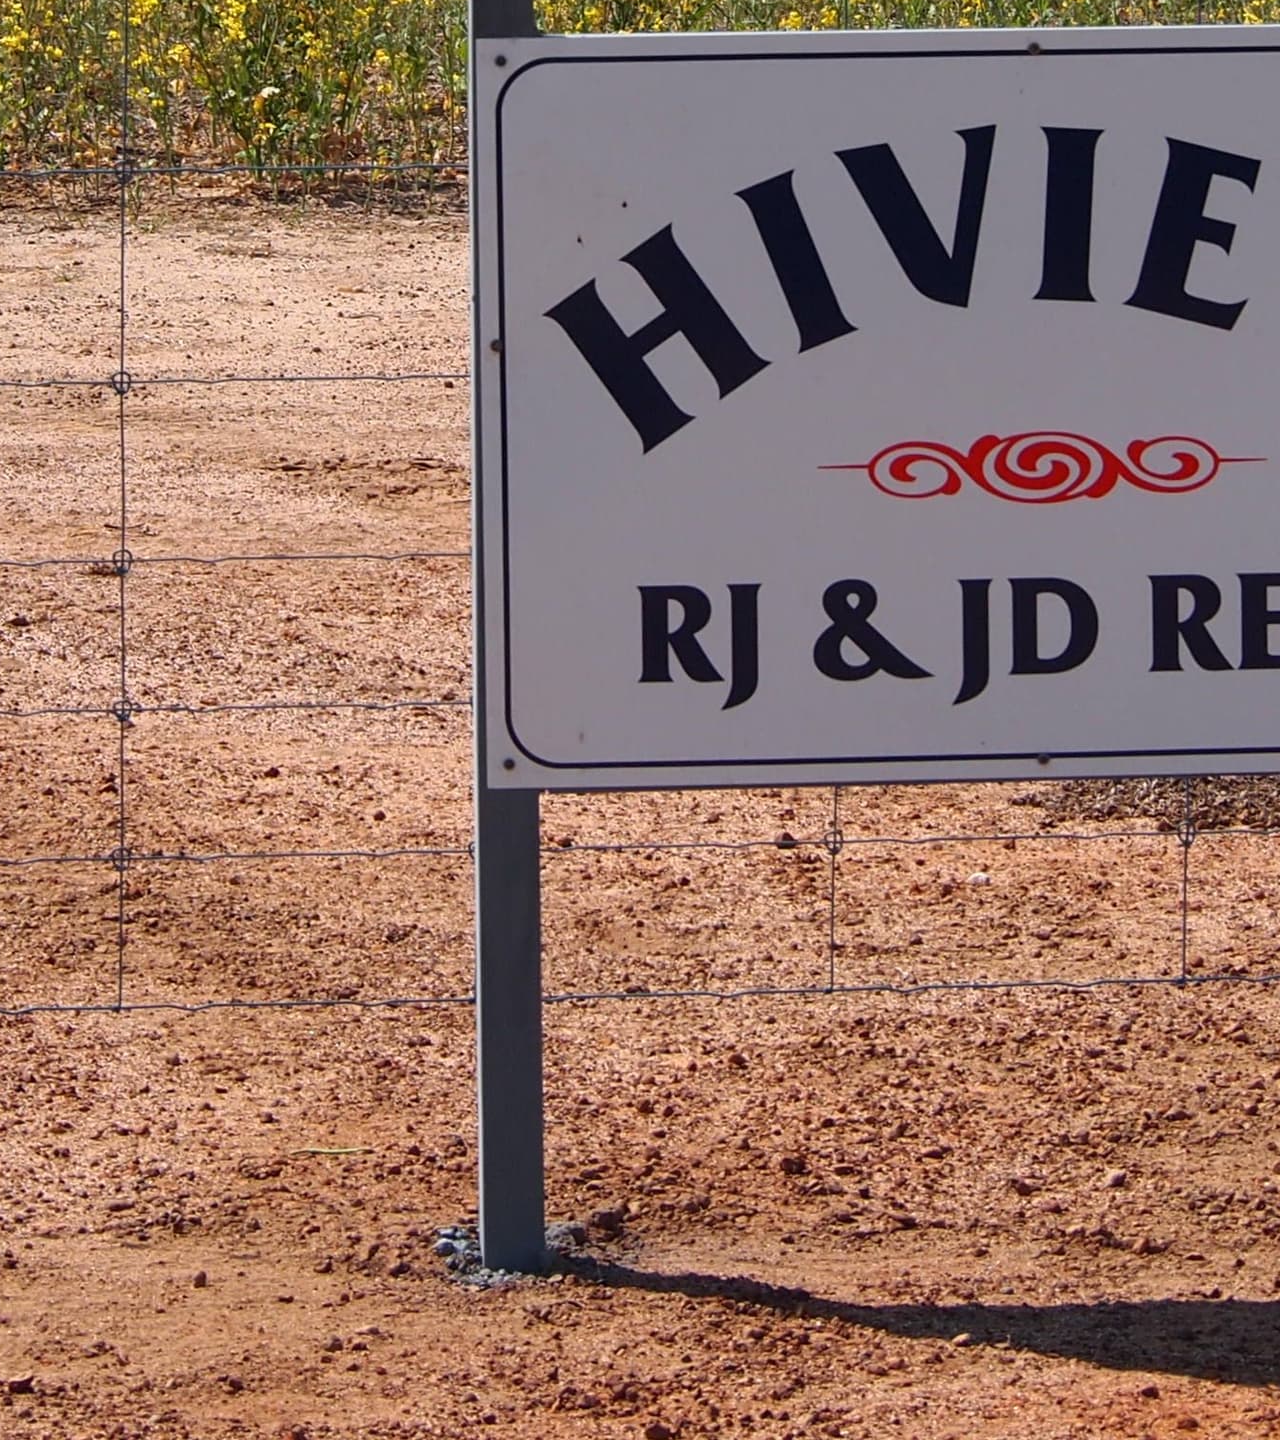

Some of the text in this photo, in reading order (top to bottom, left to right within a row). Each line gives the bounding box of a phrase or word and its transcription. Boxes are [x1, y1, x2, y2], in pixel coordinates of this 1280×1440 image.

[636, 582, 763, 711] RJ
[812, 578, 935, 682] &
[951, 576, 1100, 707] JD
